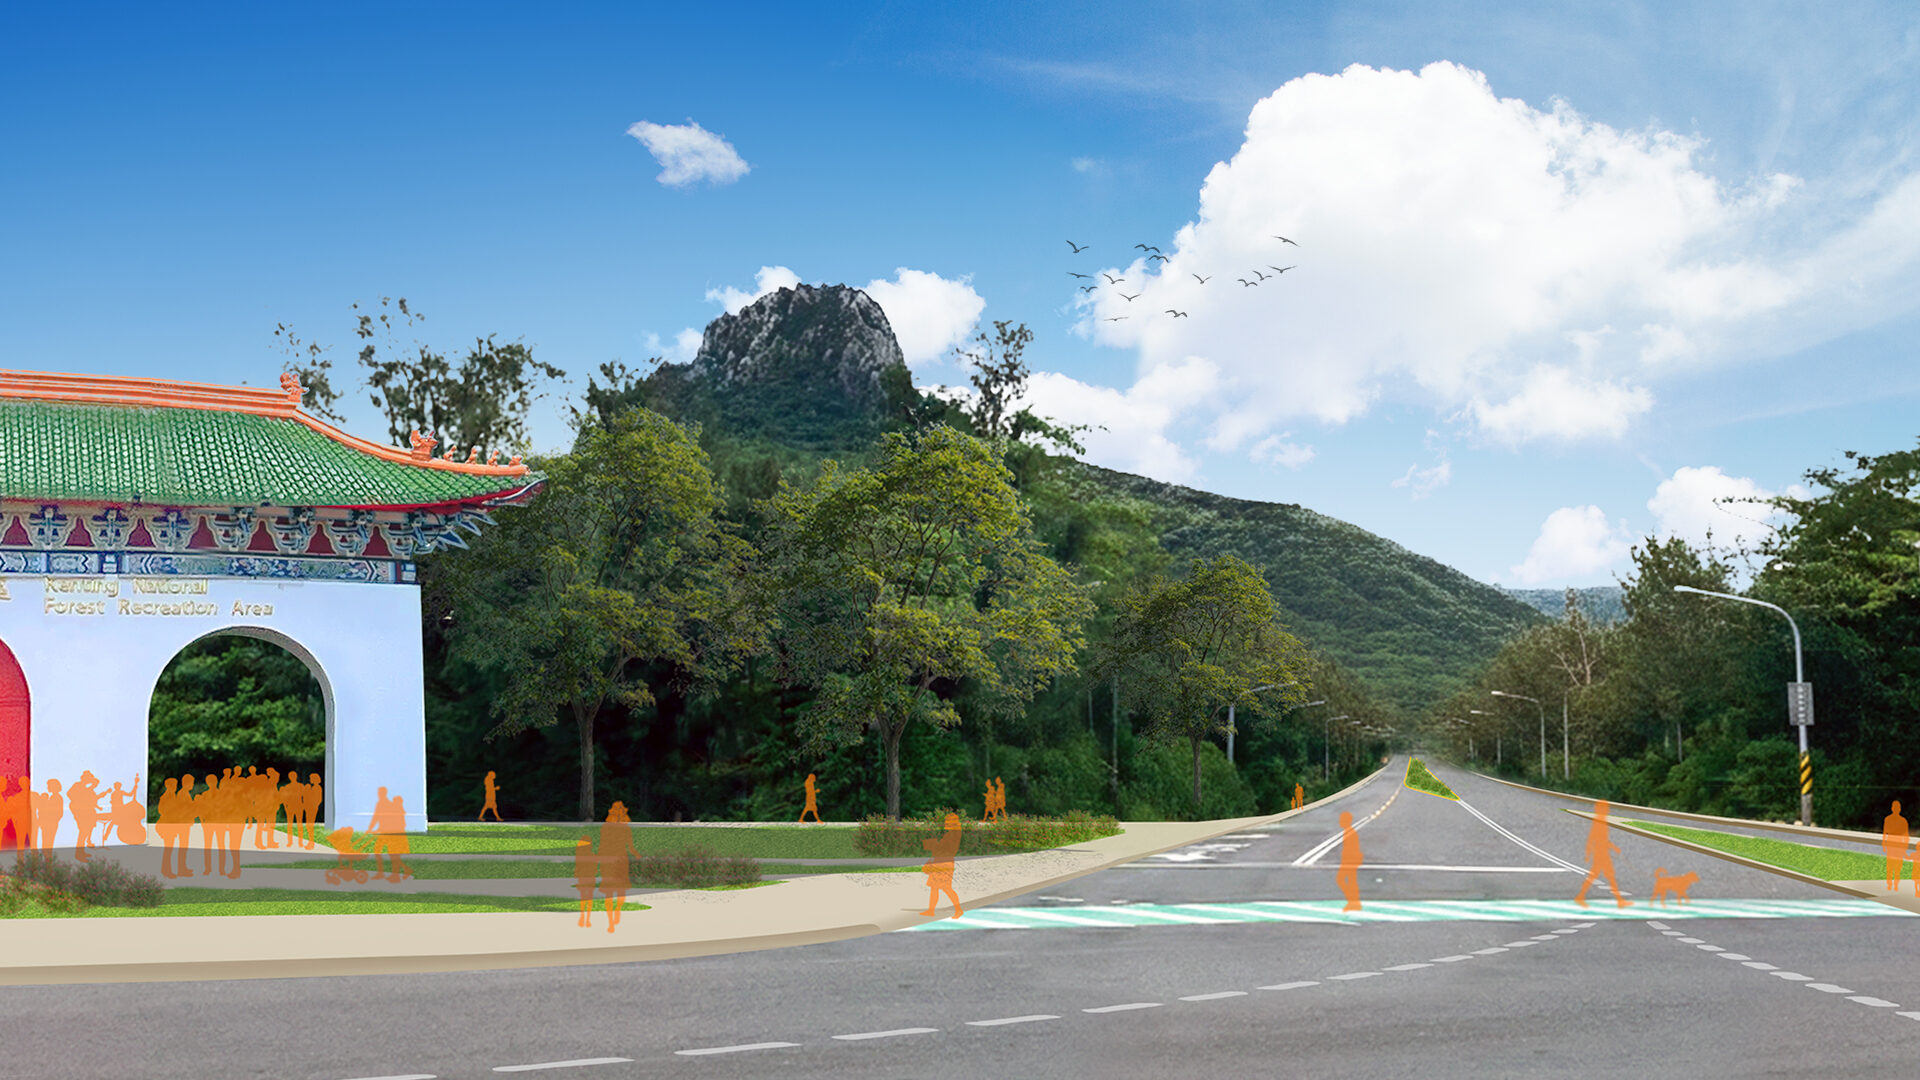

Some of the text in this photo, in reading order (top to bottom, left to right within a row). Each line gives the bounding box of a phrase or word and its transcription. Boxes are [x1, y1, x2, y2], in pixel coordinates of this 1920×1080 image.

[45, 577, 208, 597] Kenting National
[44, 598, 274, 616] Forest Recreation Area
